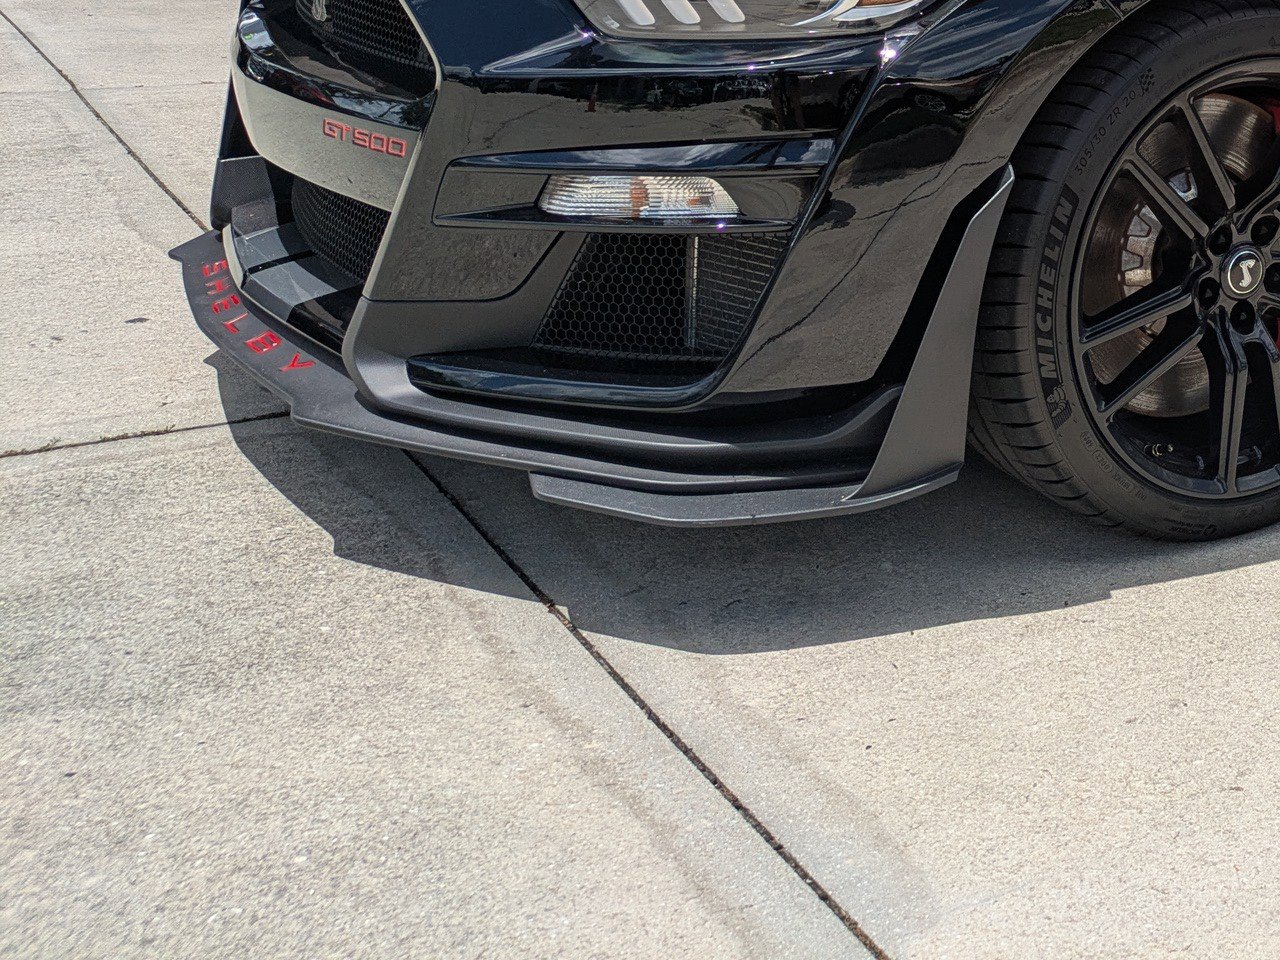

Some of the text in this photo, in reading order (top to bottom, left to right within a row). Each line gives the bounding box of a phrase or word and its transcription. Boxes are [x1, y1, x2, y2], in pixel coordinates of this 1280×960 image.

[1075, 90, 1136, 176] 305/30 ZR 20
[202, 259, 316, 373] SHELBY
[1036, 197, 1076, 380] MICHELIN
